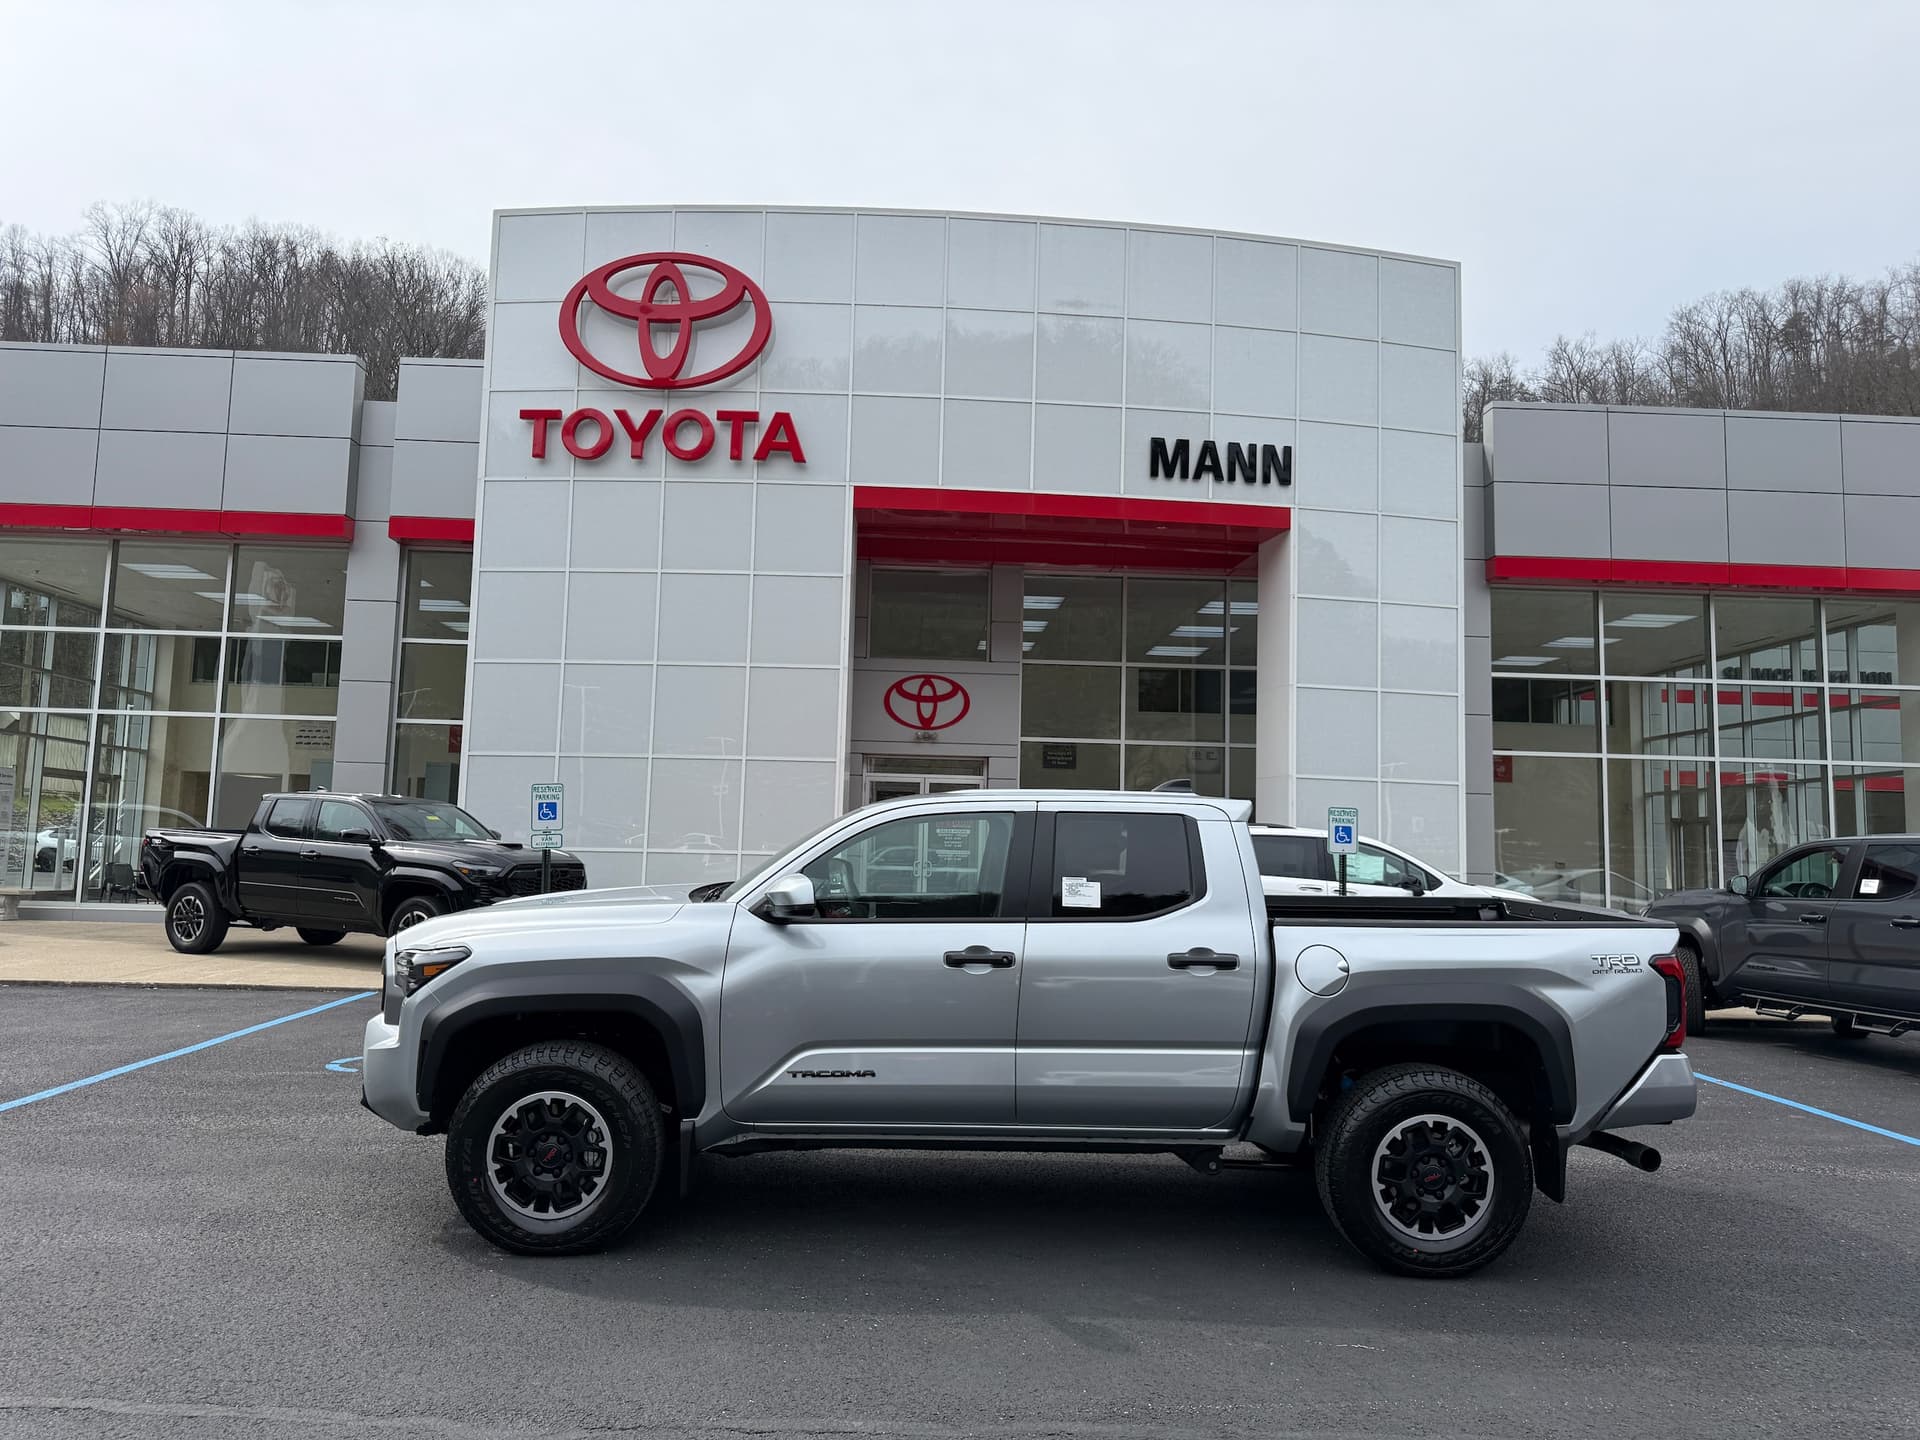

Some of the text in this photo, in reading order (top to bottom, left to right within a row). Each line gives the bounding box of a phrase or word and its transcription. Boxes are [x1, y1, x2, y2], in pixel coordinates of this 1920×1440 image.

[519, 408, 806, 463] TOYOTA
[1150, 437, 1292, 486] MANN
[1591, 954, 1640, 969] TRD
[787, 1069, 876, 1078] TACOMA
